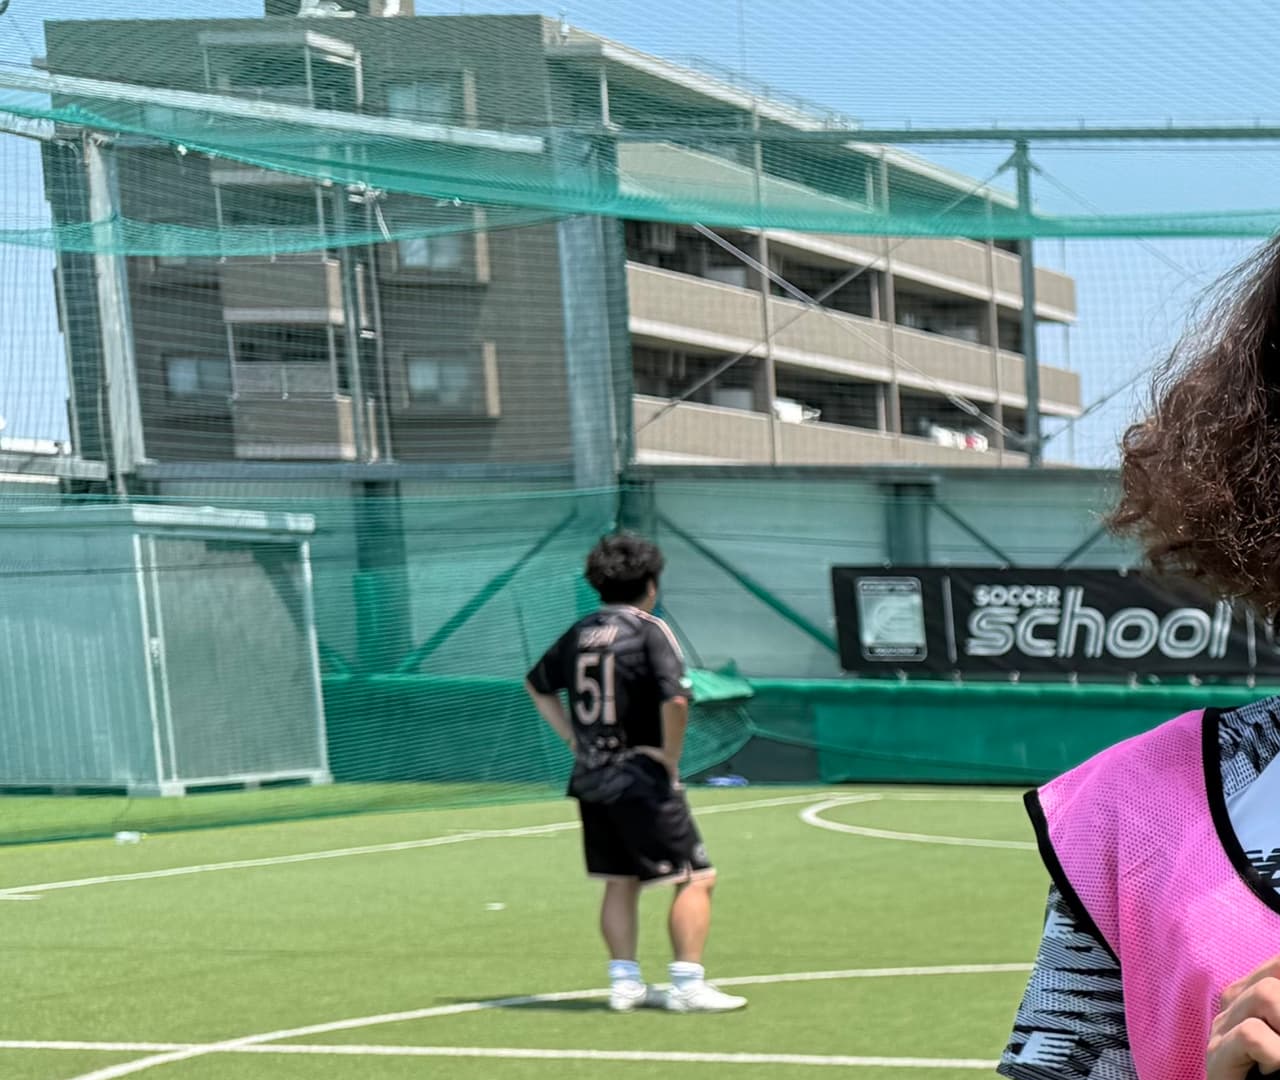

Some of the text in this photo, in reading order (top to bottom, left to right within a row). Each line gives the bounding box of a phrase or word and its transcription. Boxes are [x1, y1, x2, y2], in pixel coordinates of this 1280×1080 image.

[966, 586, 1233, 659] school
[973, 585, 1061, 607] SOCCER
[576, 651, 617, 726] 51
